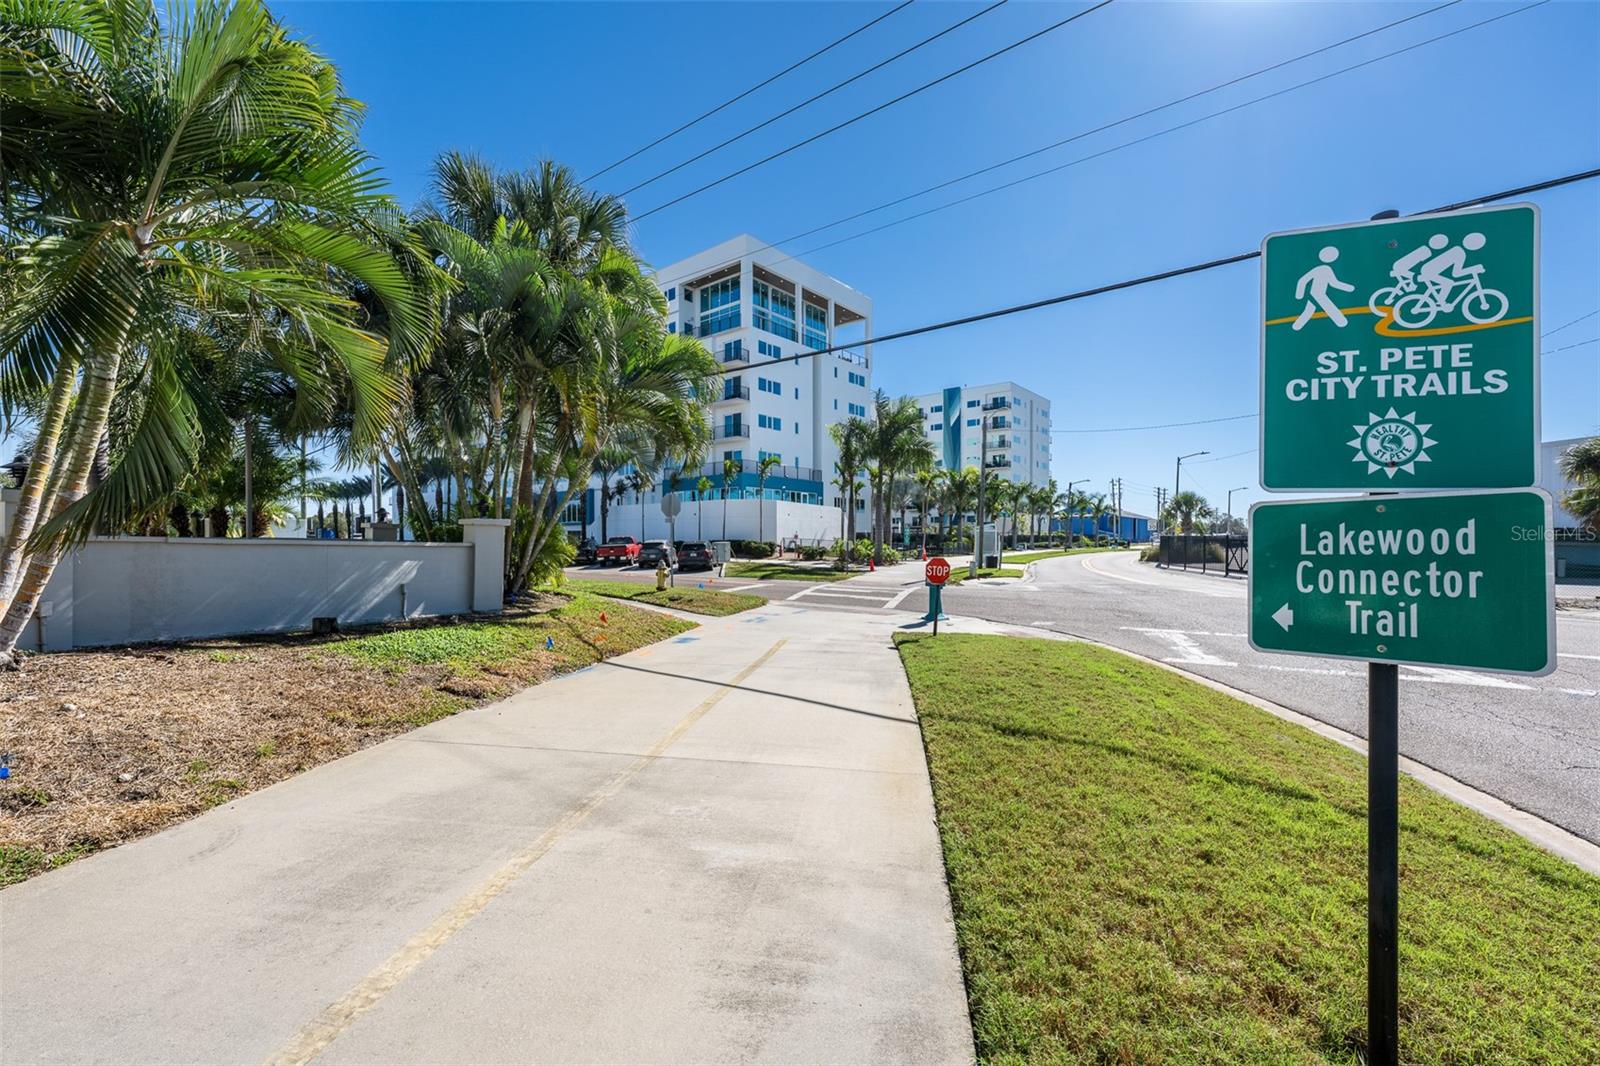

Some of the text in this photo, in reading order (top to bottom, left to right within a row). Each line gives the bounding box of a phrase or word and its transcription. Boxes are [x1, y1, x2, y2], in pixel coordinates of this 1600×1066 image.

[1316, 343, 1473, 374] ST. PETE
[1286, 369, 1509, 402] CITY TRAILS
[1370, 424, 1412, 440] HEALTHY
[1389, 446, 1412, 461] PETE
[1300, 518, 1477, 556] Lakewood
[926, 565, 949, 576] STOP
[1296, 561, 1483, 598] Connector
[1345, 600, 1418, 638] Trail
